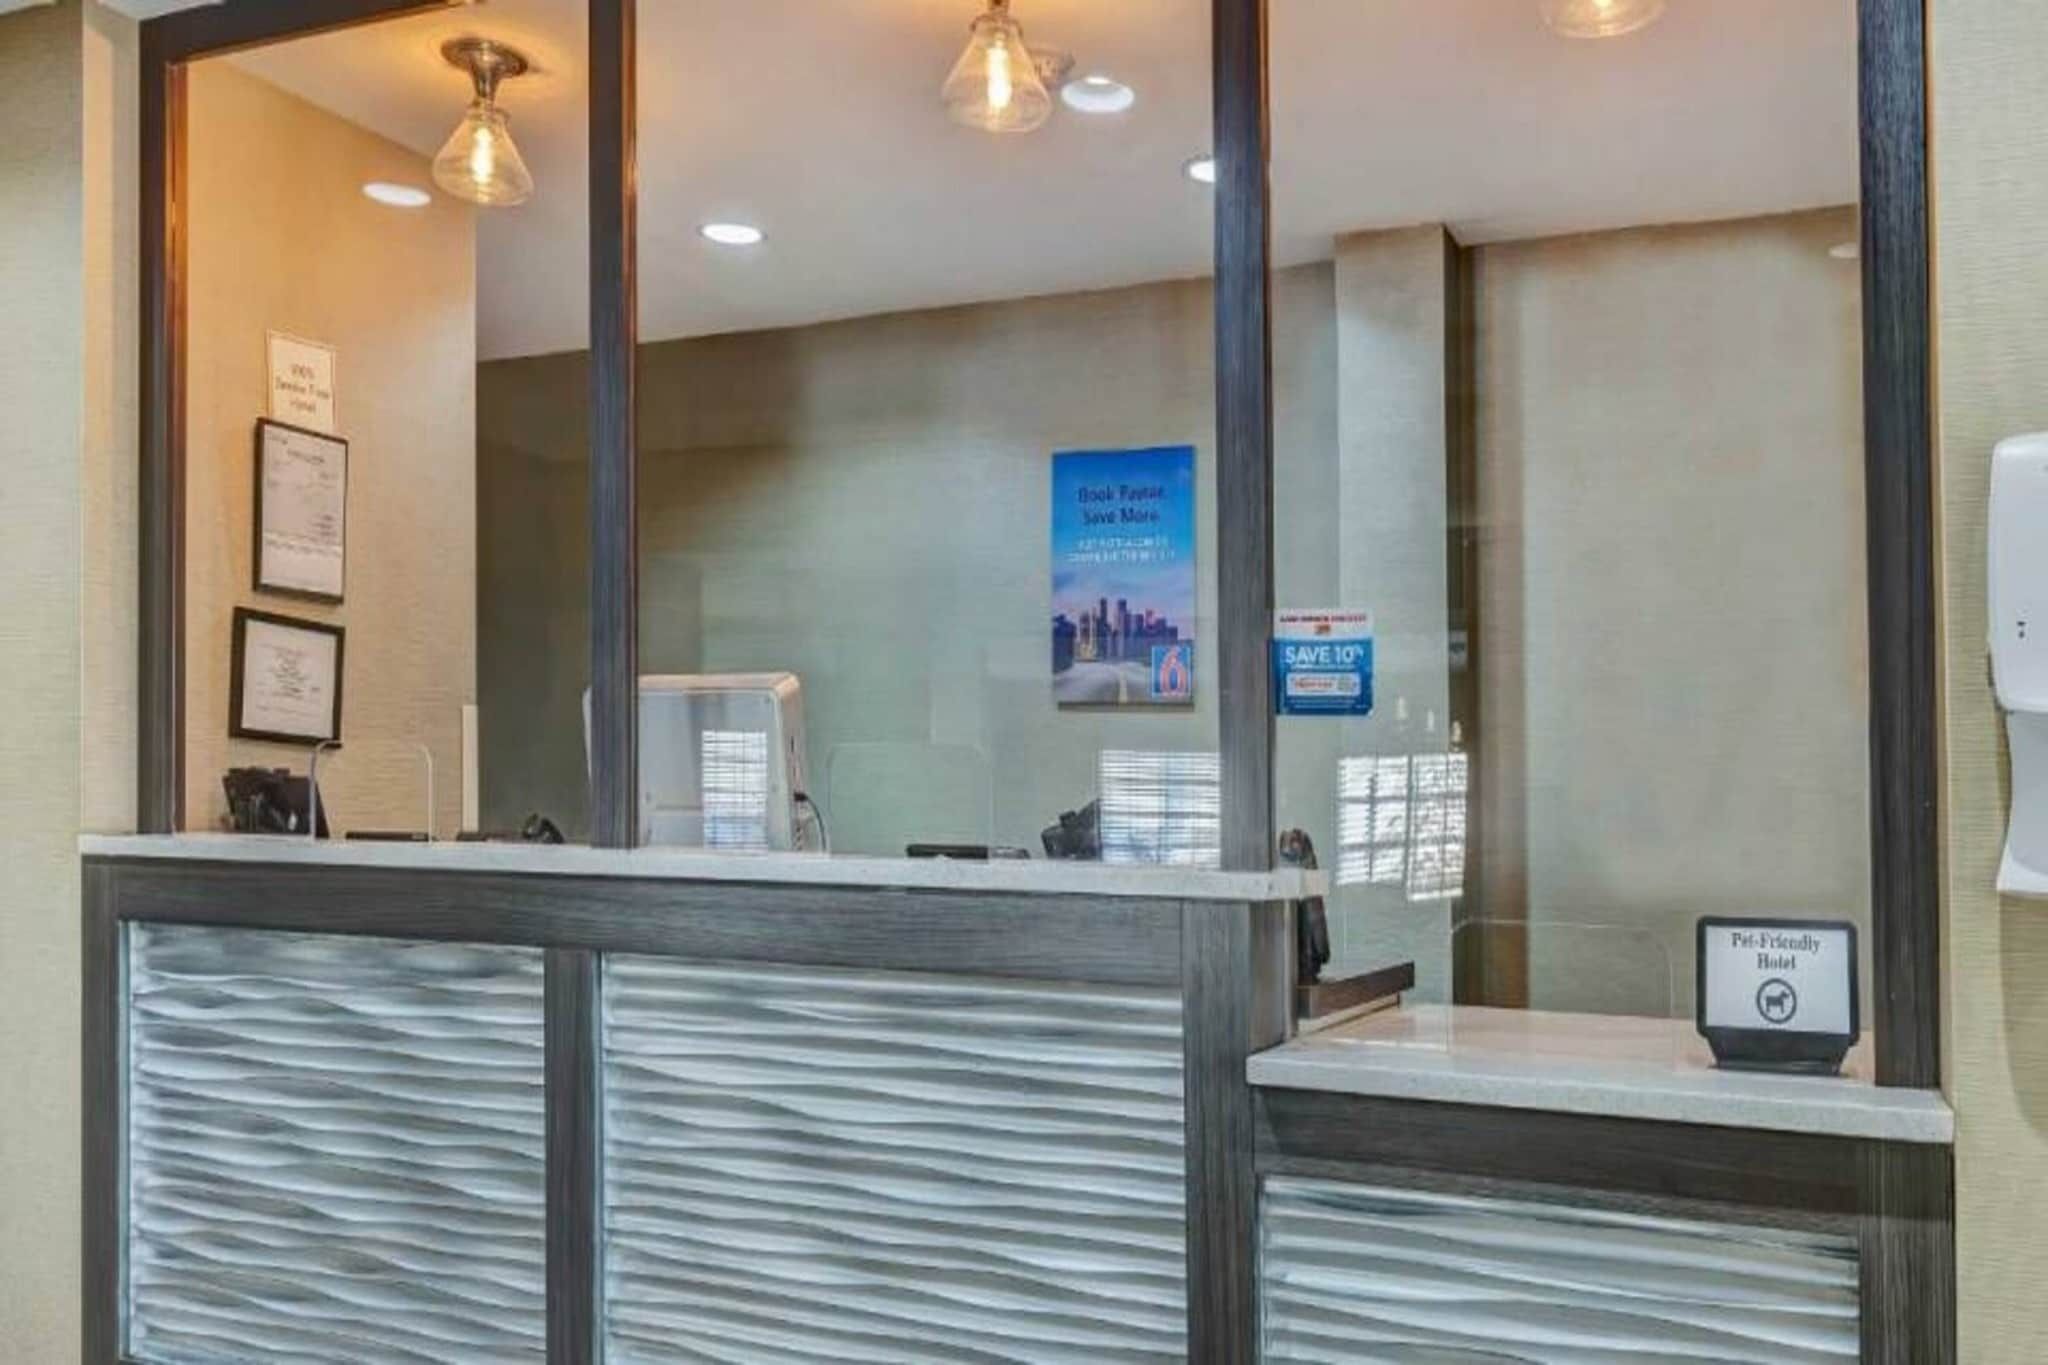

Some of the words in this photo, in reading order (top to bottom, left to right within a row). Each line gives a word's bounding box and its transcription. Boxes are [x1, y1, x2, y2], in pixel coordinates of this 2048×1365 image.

[1078, 484, 1115, 503] Book
[1083, 508, 1116, 526] Save
[1285, 645, 1332, 665] SAVE
[1731, 932, 1821, 955] Pet-Friendly
[1757, 952, 1797, 970] Hotel
